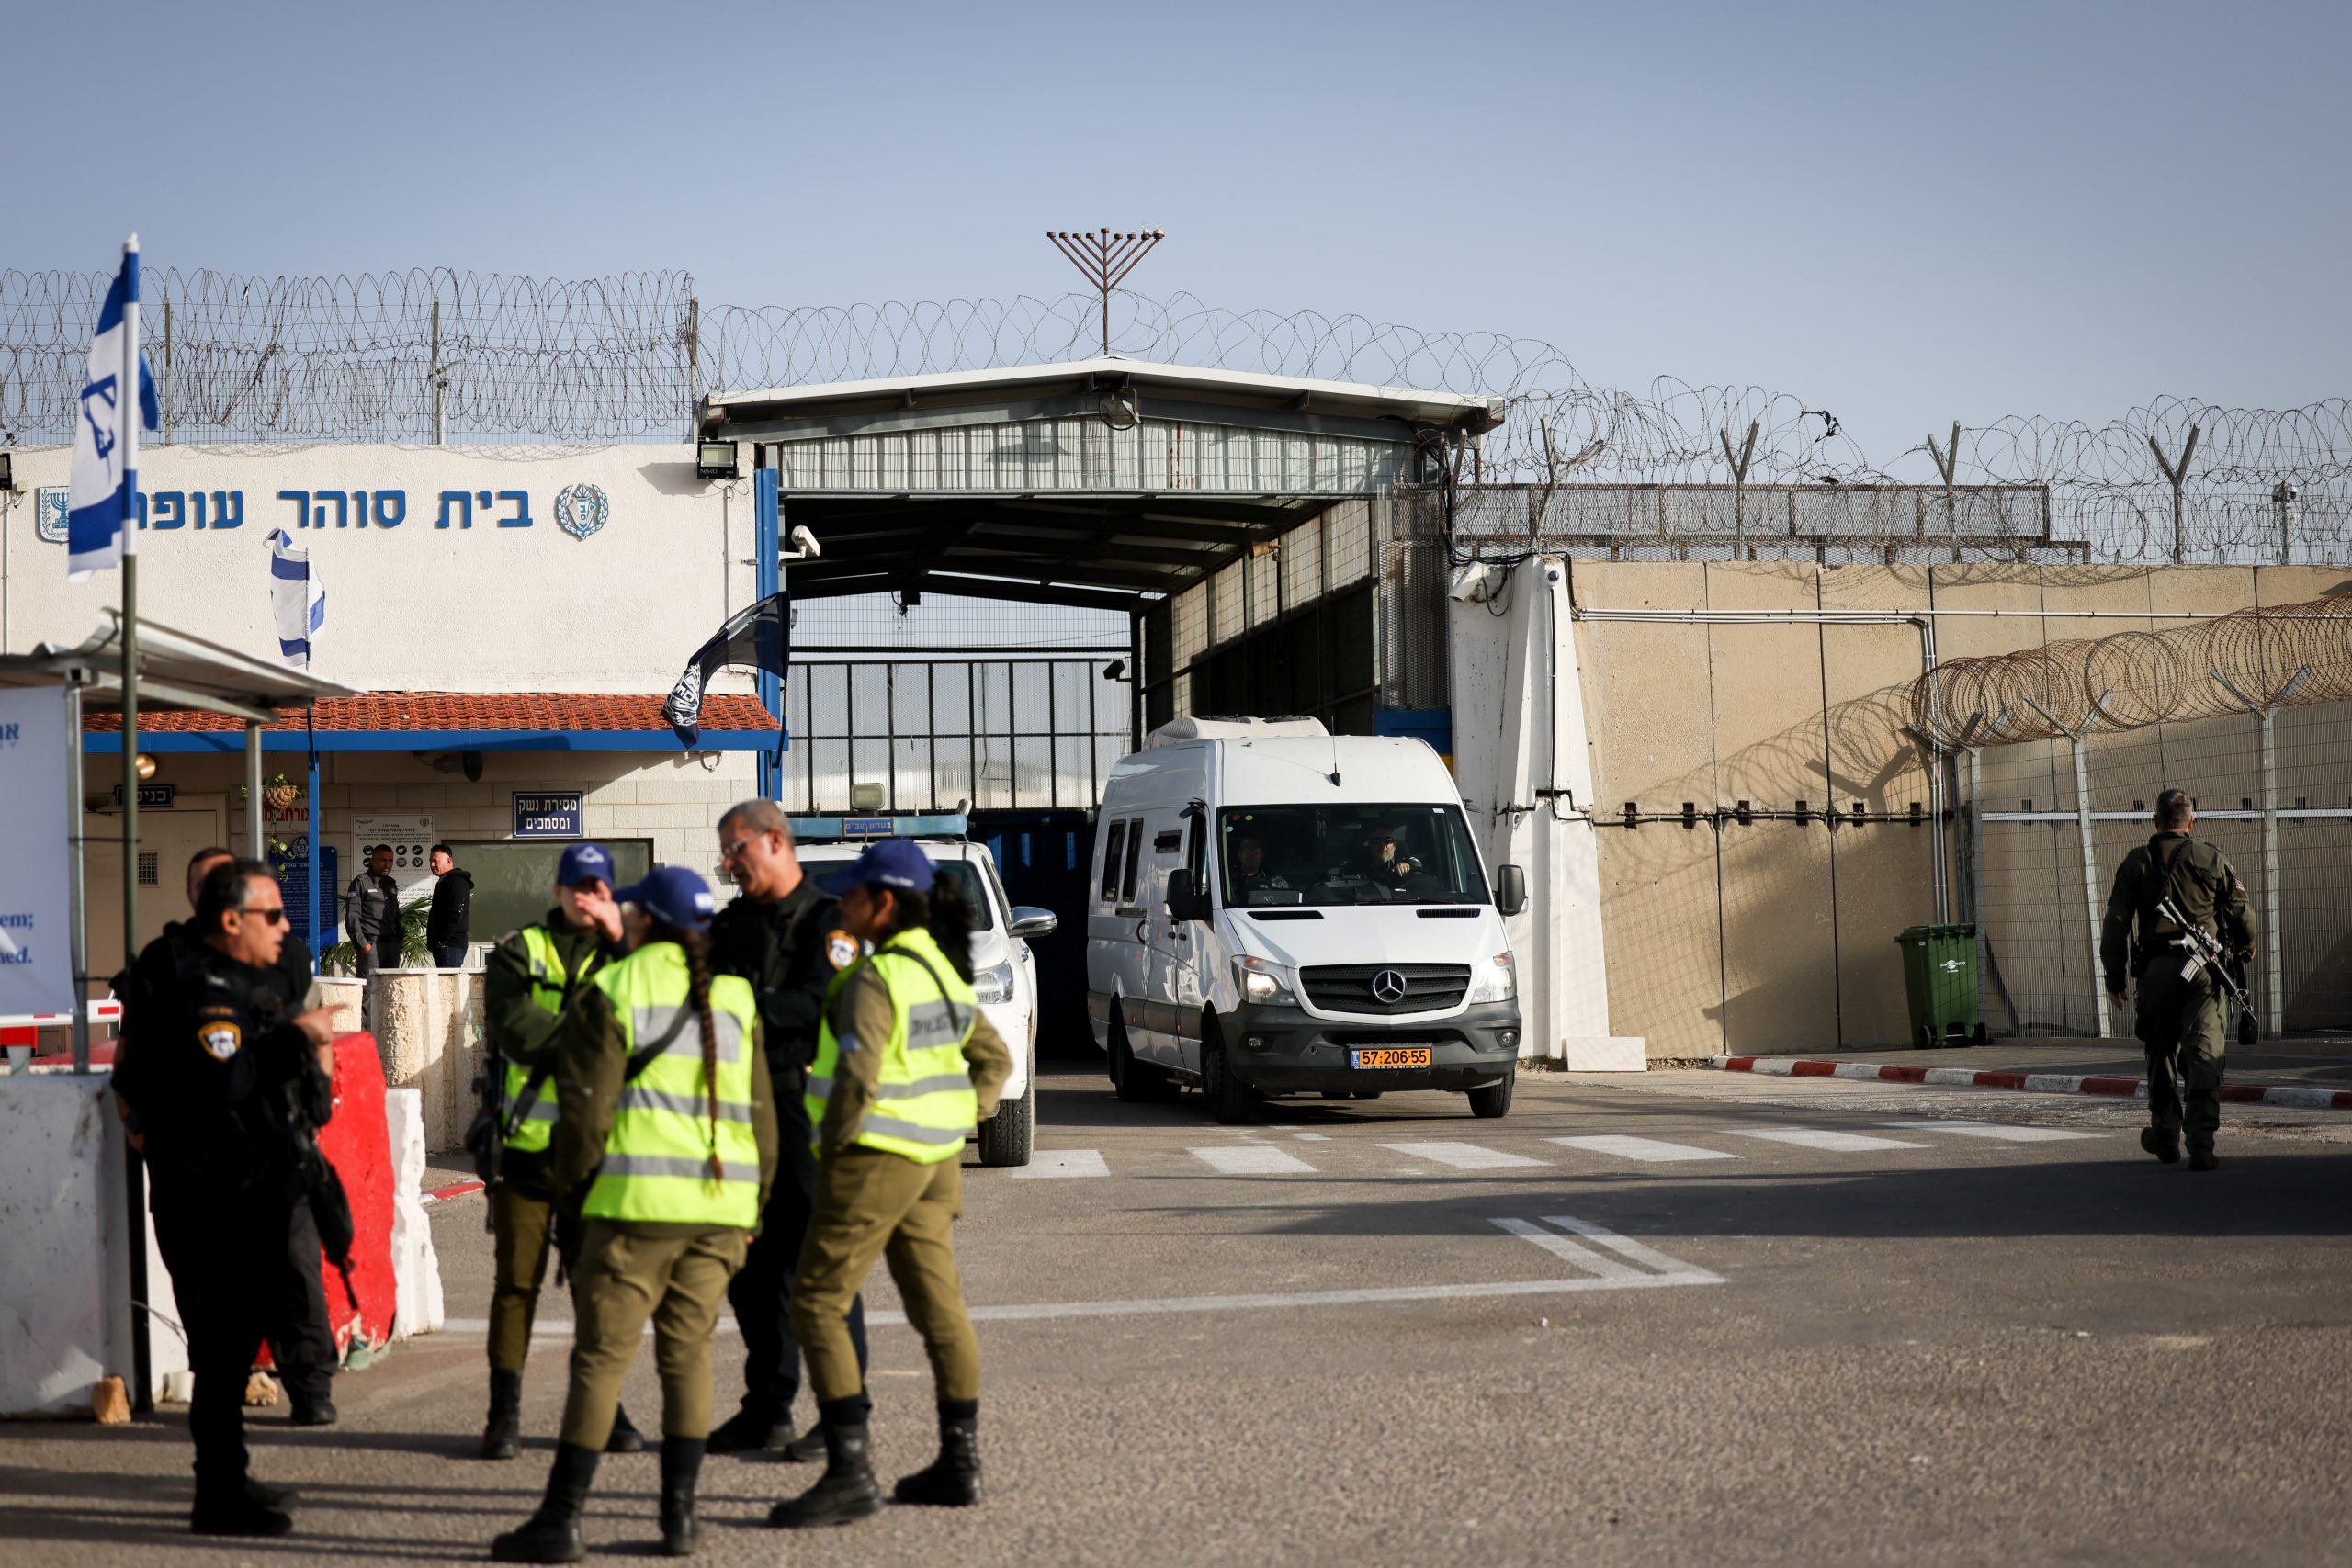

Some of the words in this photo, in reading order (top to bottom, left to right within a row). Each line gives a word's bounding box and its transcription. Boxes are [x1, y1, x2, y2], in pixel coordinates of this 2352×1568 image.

[279, 490, 406, 528] סוהר
[436, 490, 533, 528] בית
[518, 799, 539, 814] נשק
[544, 799, 577, 811] מסירת
[526, 818, 571, 830] ומסמכים
[869, 821, 891, 830] בטחון
